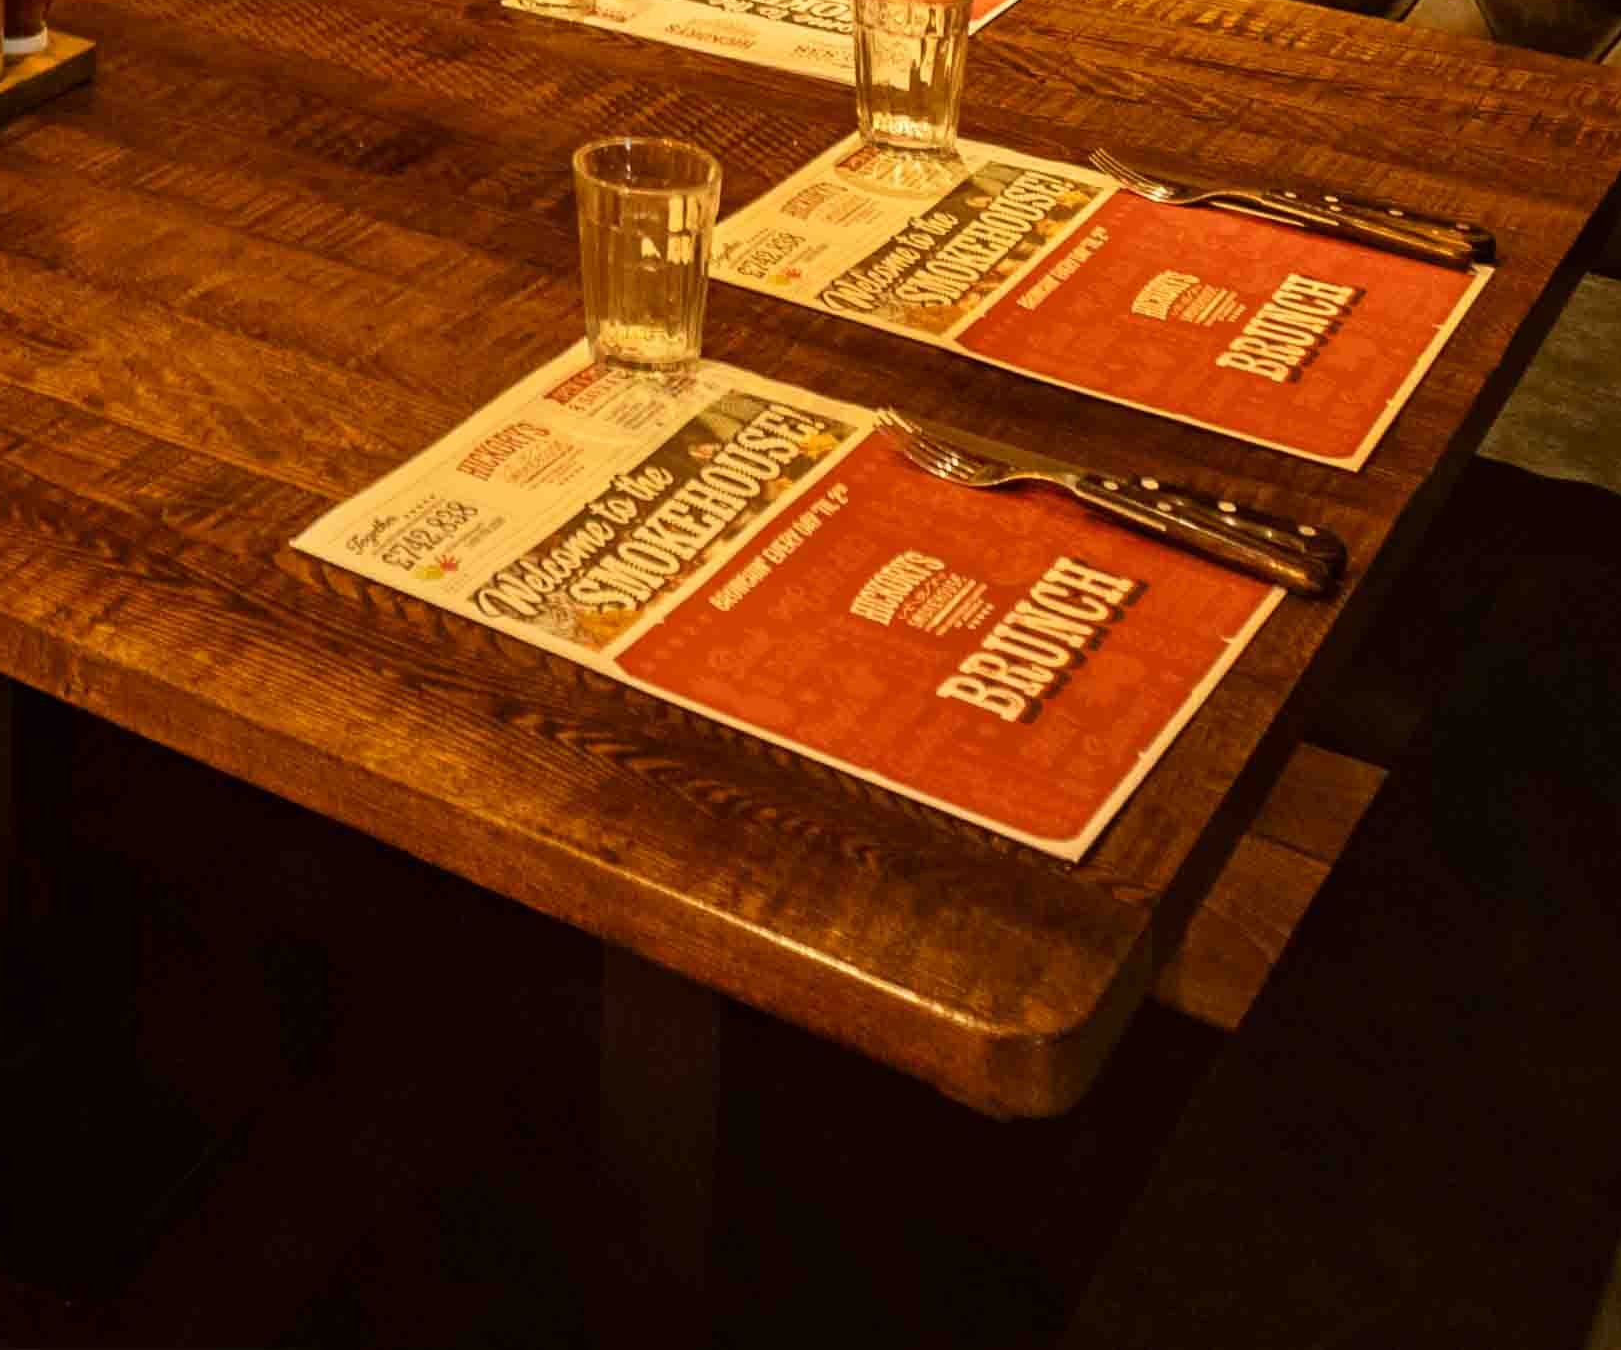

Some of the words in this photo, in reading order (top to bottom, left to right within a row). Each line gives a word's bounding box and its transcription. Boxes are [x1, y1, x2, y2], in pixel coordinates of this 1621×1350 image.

[822, 248, 920, 311] Welcome
[909, 211, 959, 236] the
[896, 171, 1076, 308] SMOKEHOUSE!
[1215, 272, 1356, 383] BRUNCH
[568, 402, 826, 613] SMOKEHOUSE!
[587, 498, 638, 524] to
[611, 465, 674, 501] the
[476, 518, 616, 619] Welcome
[936, 555, 1137, 724] BRUNCH
